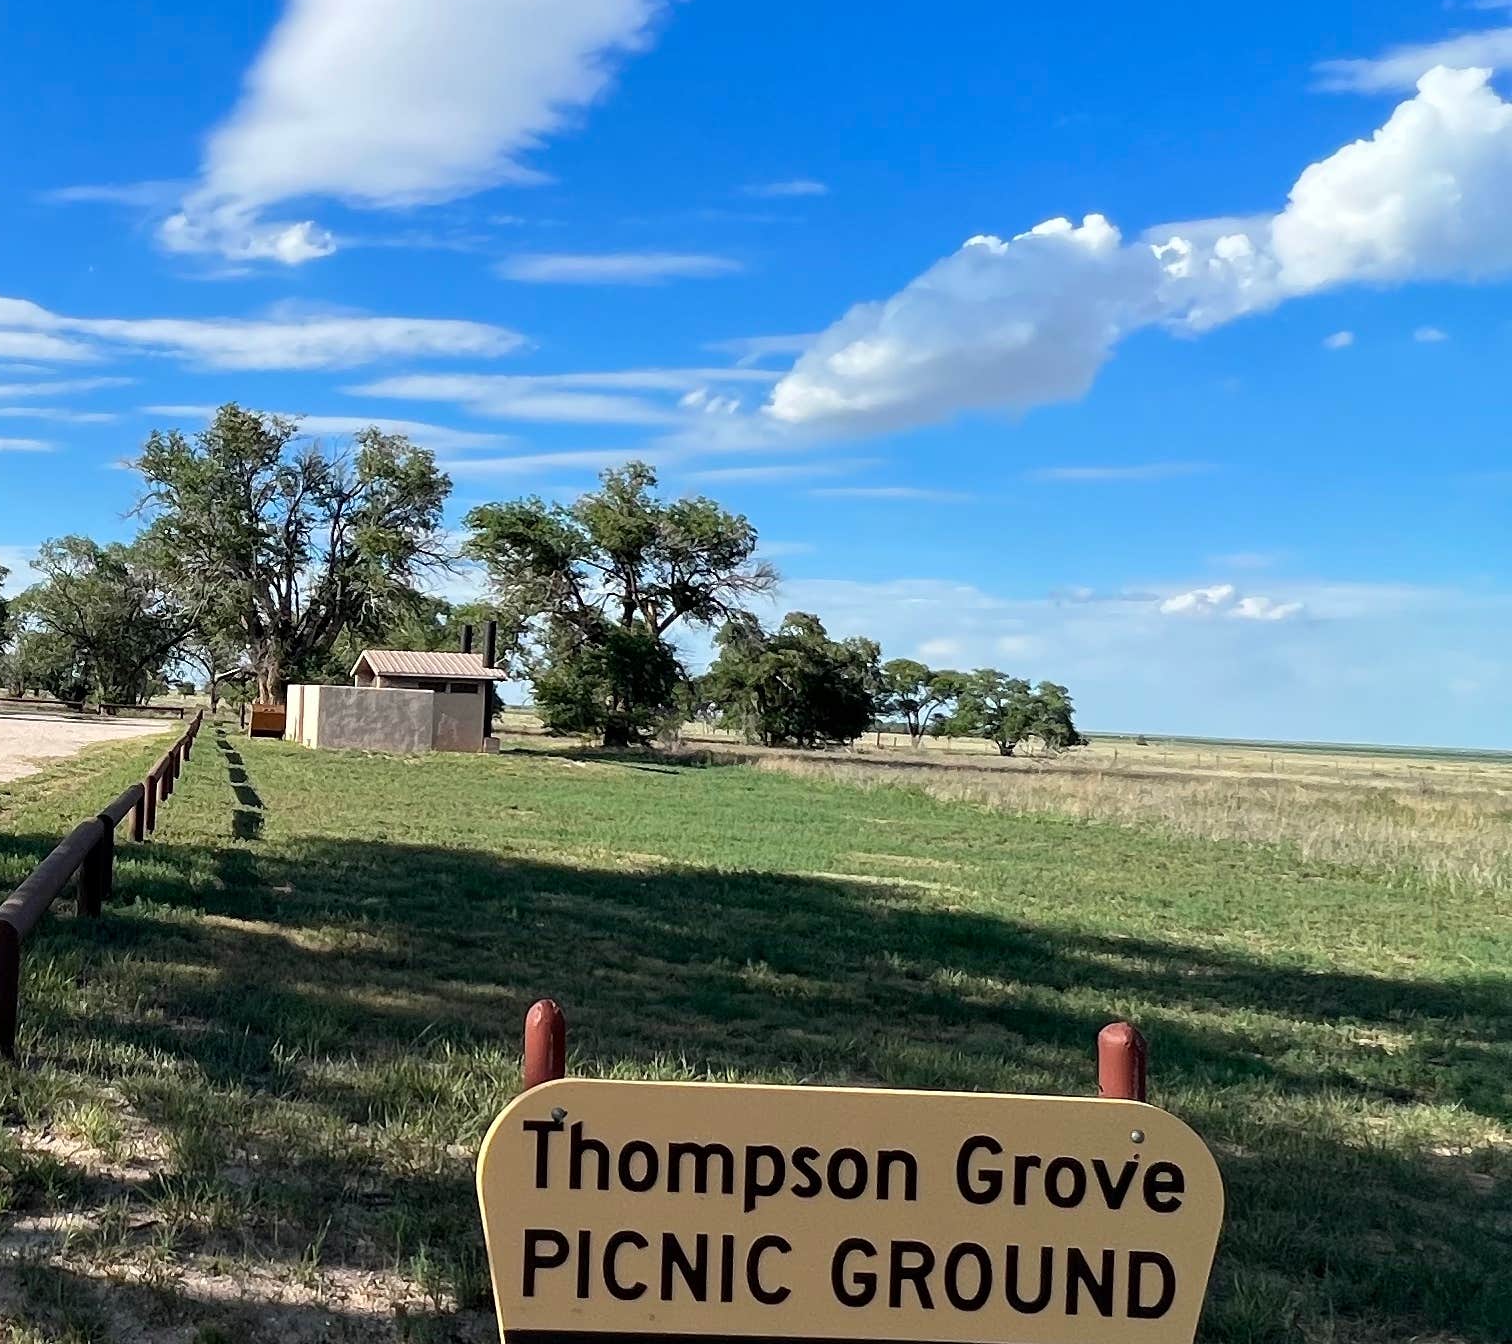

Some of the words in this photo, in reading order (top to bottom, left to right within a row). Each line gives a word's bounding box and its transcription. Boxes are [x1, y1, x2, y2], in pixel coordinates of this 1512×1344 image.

[522, 1119, 919, 1213] Thompson
[955, 1134, 1186, 1214] Grove
[522, 1228, 793, 1305] PICNIC
[830, 1237, 1177, 1320] GROUND
